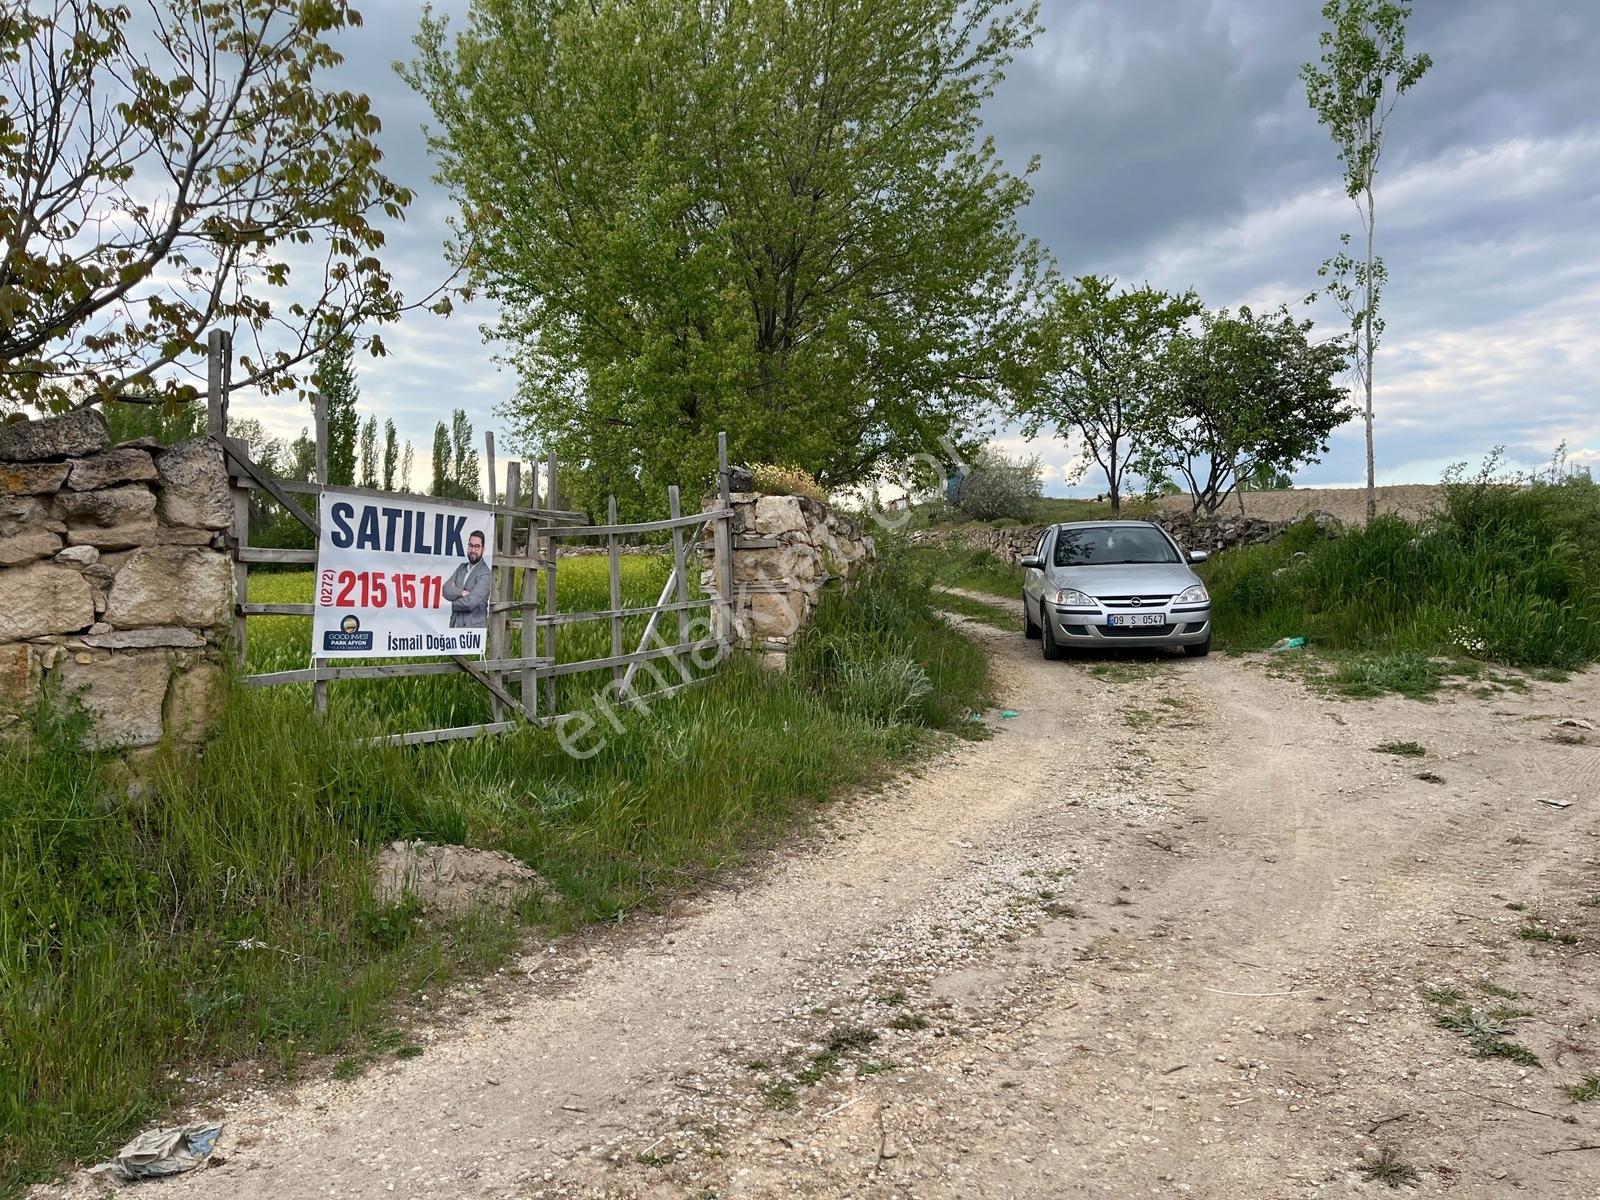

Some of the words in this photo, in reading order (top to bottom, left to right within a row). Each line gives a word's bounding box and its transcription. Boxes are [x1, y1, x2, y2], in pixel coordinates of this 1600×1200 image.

[331, 501, 467, 556] SATILIK
[320, 569, 336, 607] (0272)
[336, 570, 387, 608] 215
[392, 574, 416, 608] 15
[420, 575, 442, 609] 11
[1114, 615, 1124, 625] 09
[1131, 615, 1136, 624] S
[1143, 615, 1162, 624] 0547
[387, 631, 423, 651] İsmail
[426, 633, 457, 651] Doğan
[459, 631, 481, 649] GÜN
